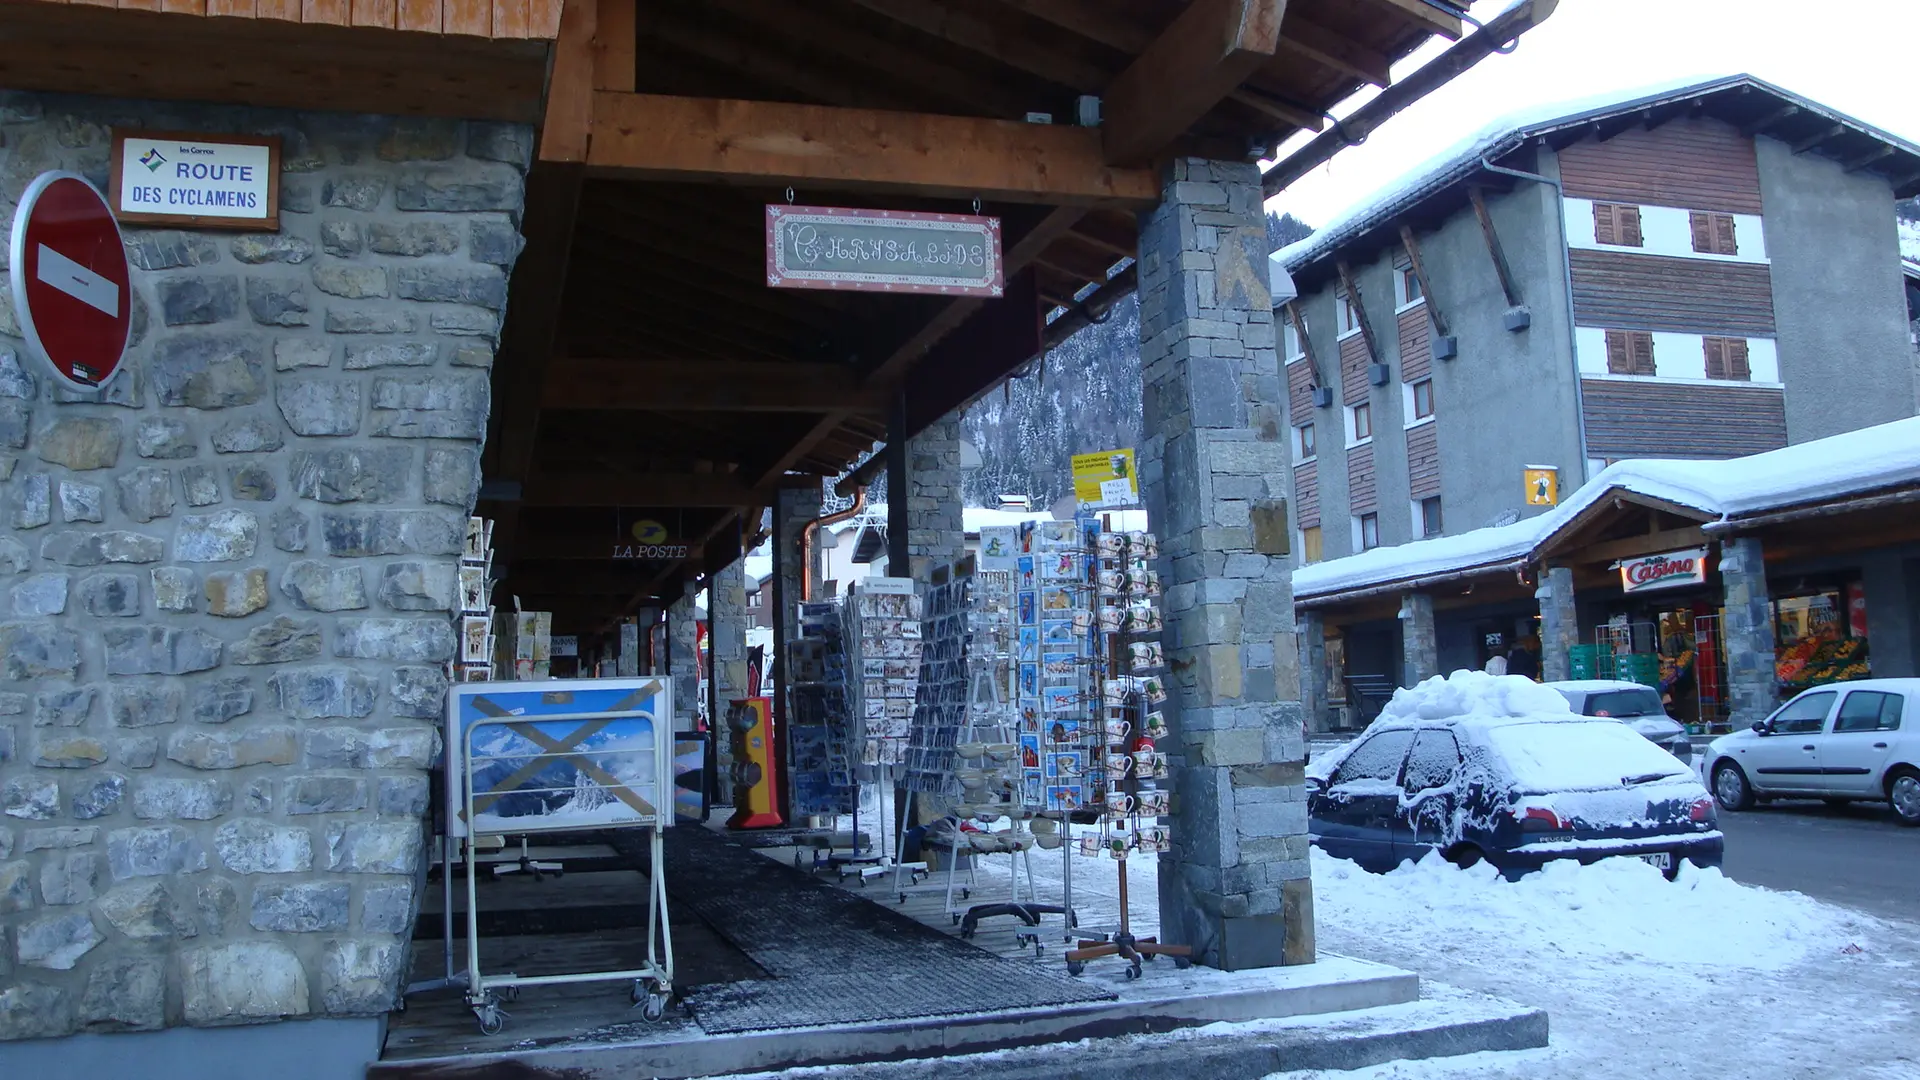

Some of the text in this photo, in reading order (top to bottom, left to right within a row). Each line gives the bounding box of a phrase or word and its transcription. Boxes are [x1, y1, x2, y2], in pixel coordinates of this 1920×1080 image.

[176, 162, 253, 182] ROUTE
[132, 186, 257, 208] DES CYCLAMENS
[612, 545, 687, 558] LA POSTE
[1626, 558, 1694, 585] Casino
[1655, 854, 1668, 868] 74
